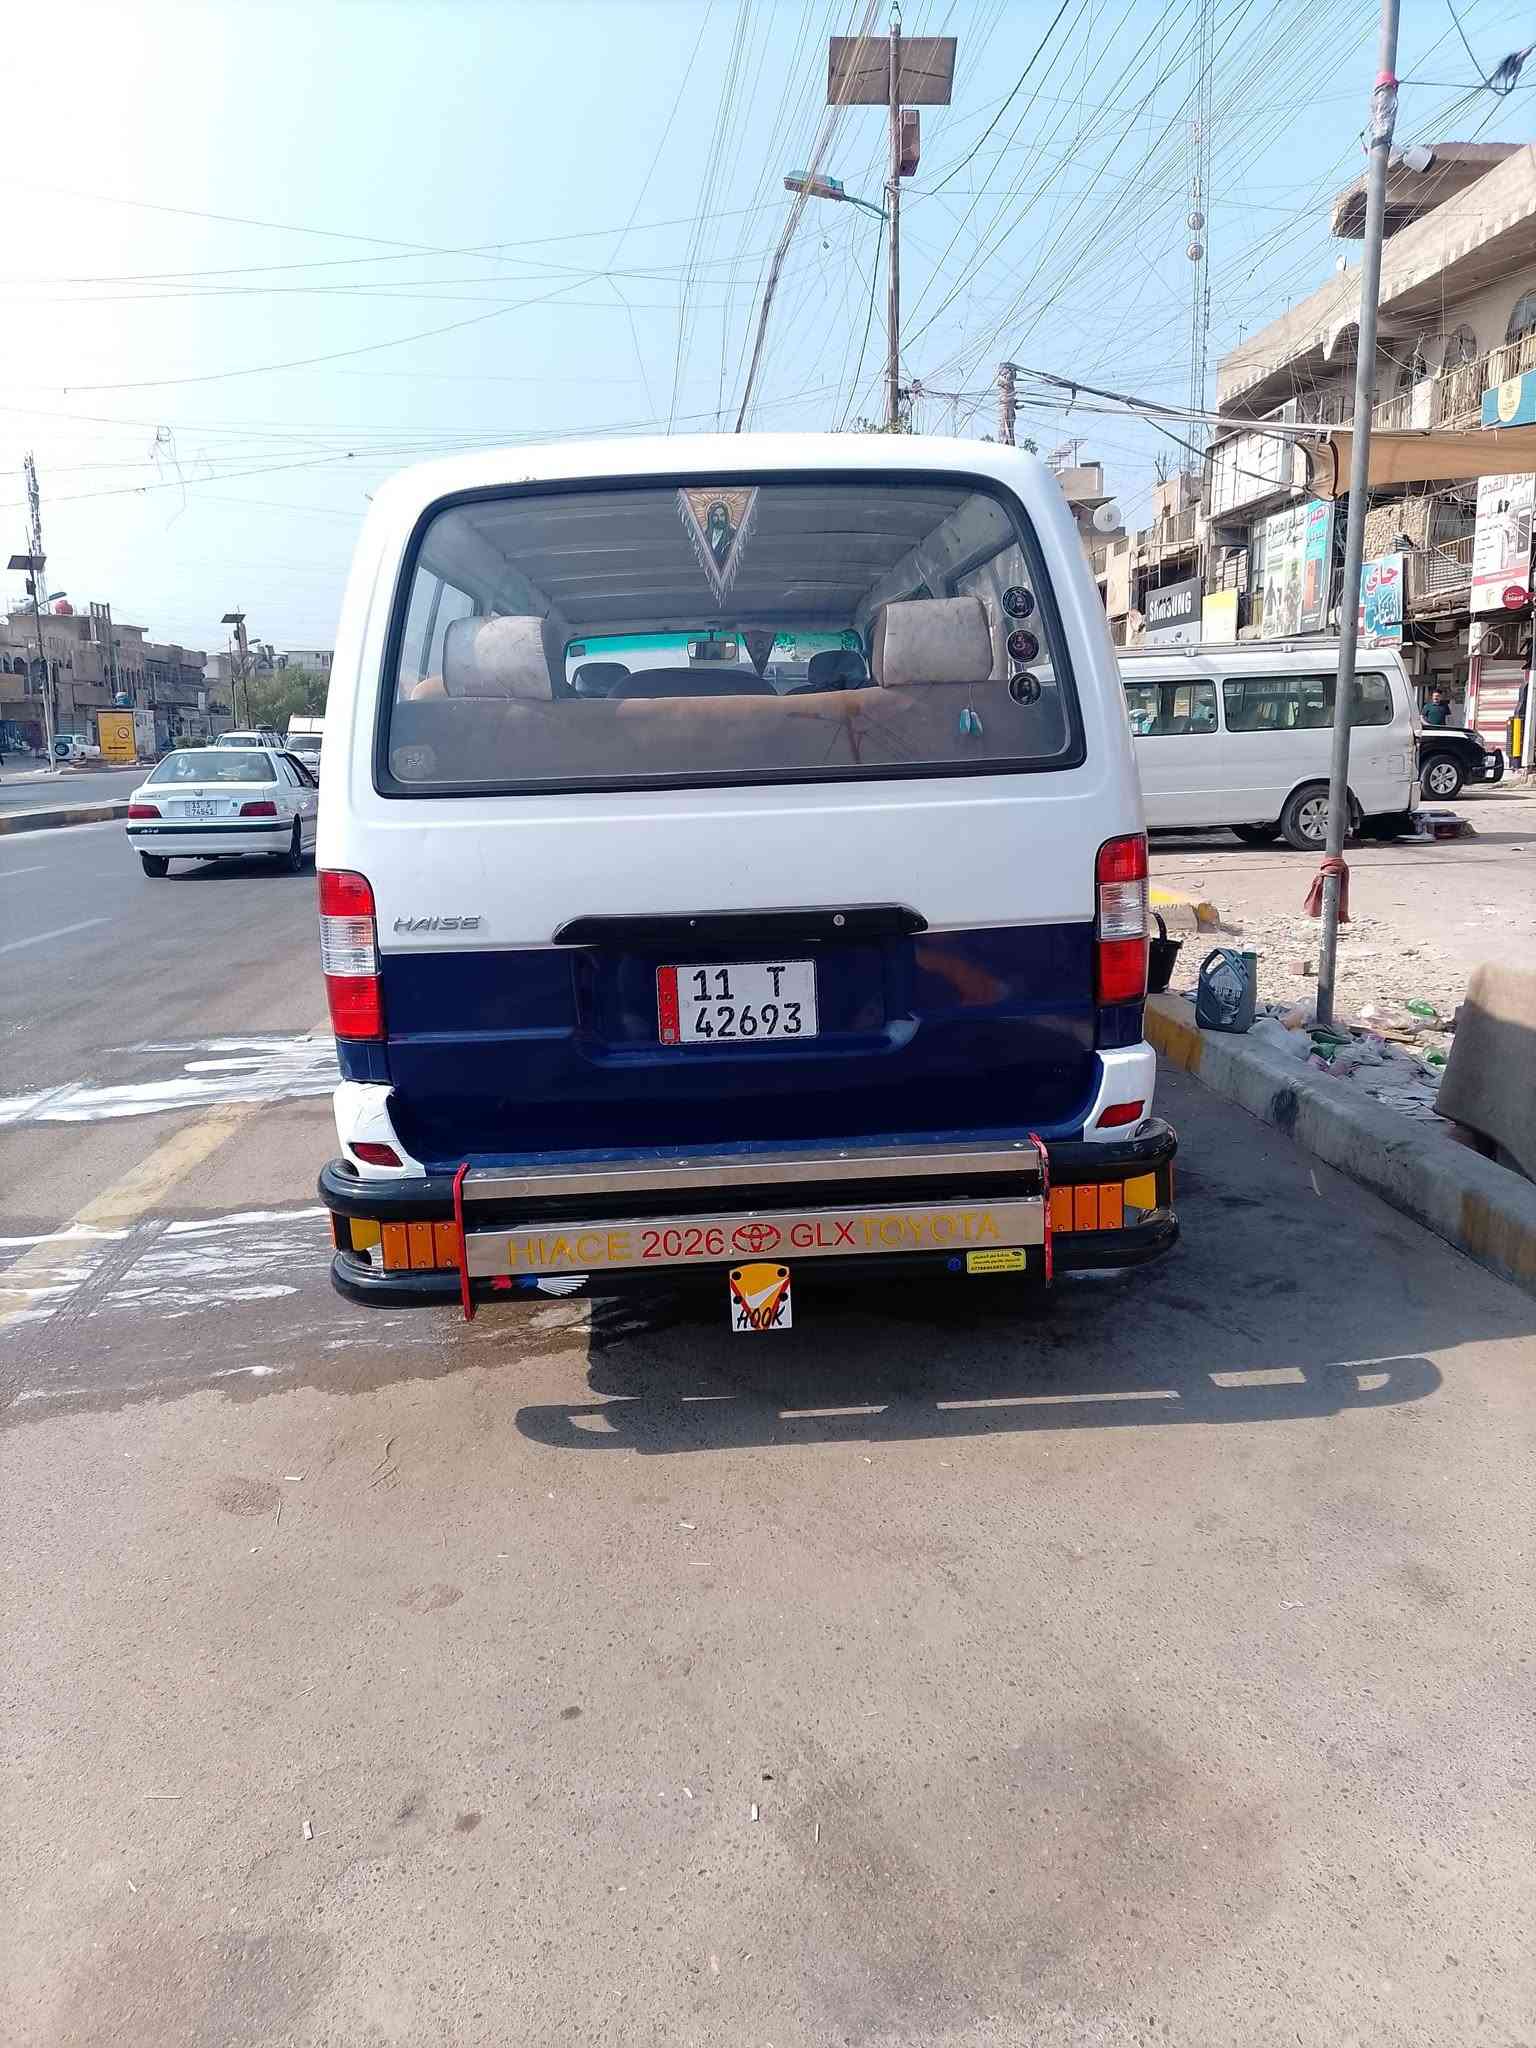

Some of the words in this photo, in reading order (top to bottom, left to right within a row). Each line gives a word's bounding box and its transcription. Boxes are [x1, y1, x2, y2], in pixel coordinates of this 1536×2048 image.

[1149, 591, 1192, 622] SAMSUNG
[393, 914, 481, 932] HAISE
[692, 969, 734, 1001] 11
[766, 966, 786, 997] T
[695, 1002, 801, 1037] 42693
[507, 1231, 633, 1265] HIACE
[641, 1228, 725, 1258] 2026
[790, 1220, 856, 1248] GLX
[862, 1211, 1000, 1246] TOYOTA
